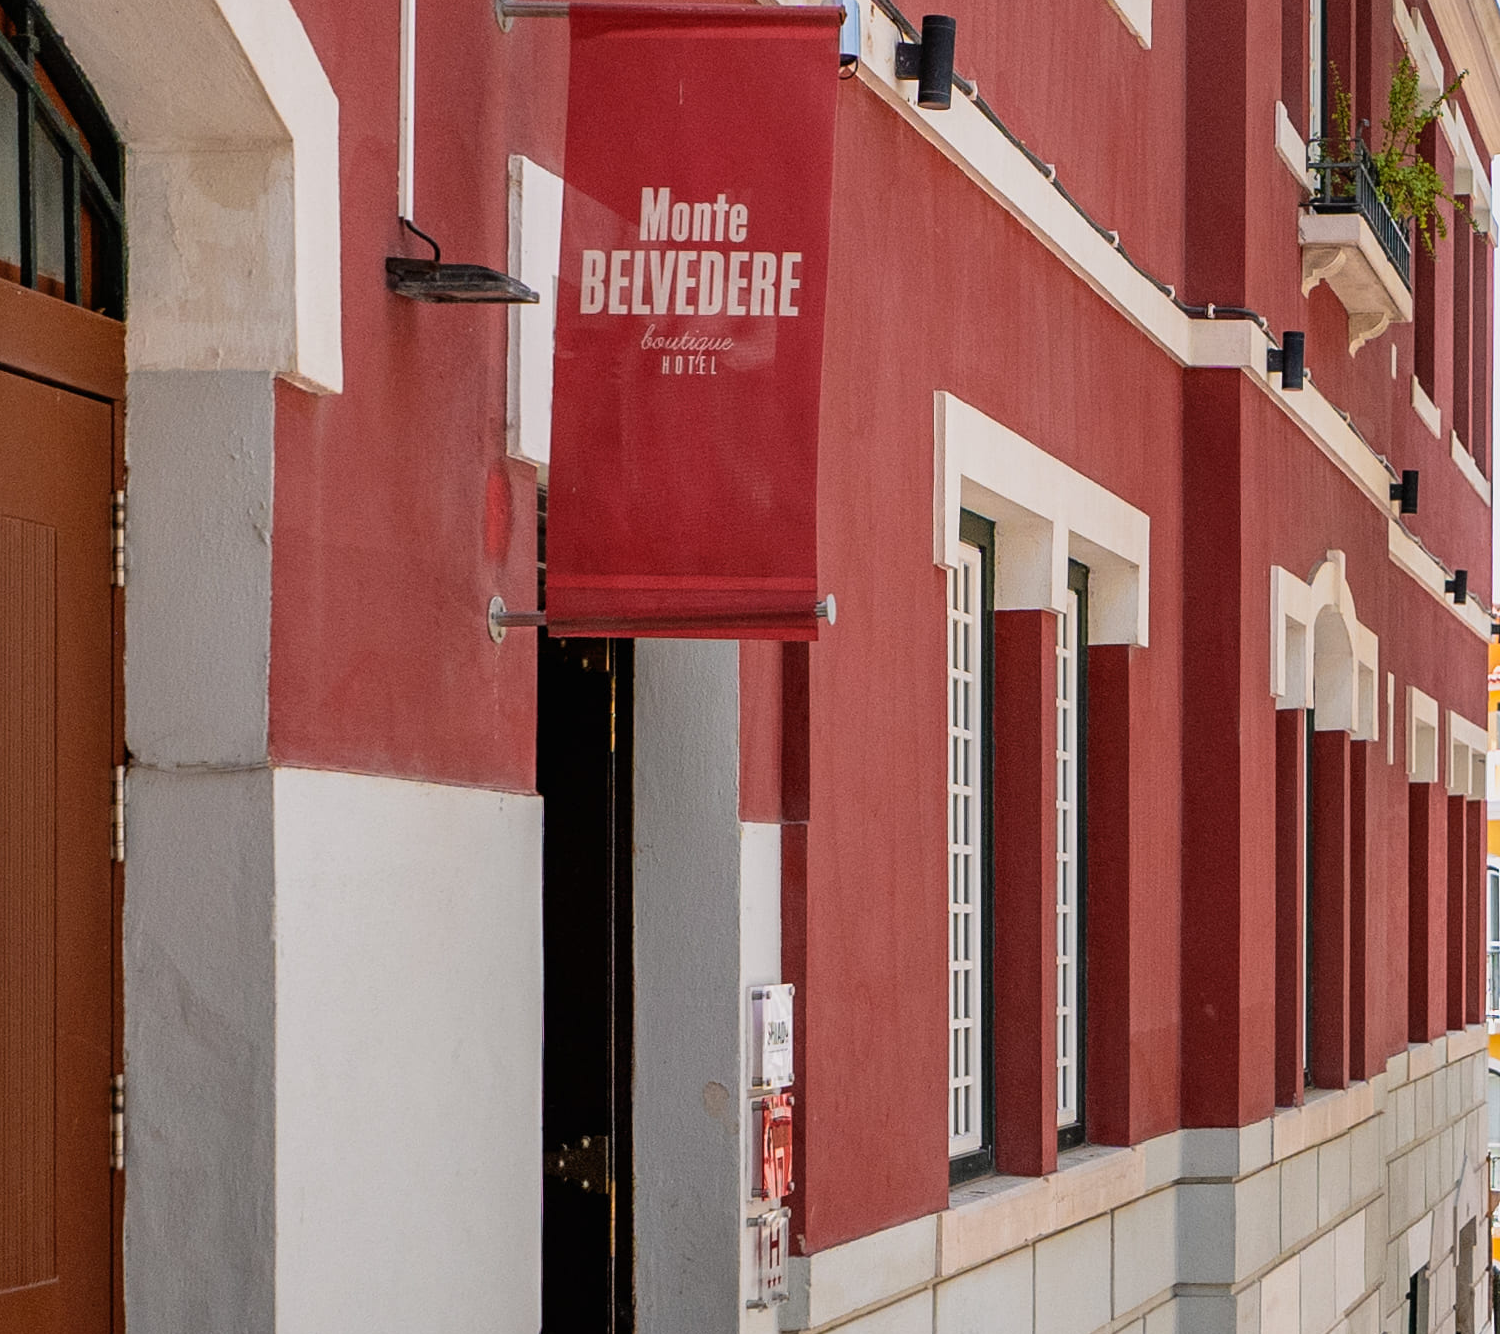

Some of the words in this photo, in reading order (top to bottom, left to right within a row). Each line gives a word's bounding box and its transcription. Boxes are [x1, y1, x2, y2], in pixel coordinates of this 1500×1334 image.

[639, 186, 749, 243] Monte
[580, 249, 803, 317] BELVEDERE
[641, 323, 734, 365] boutique
[661, 355, 717, 375] HOTEL
